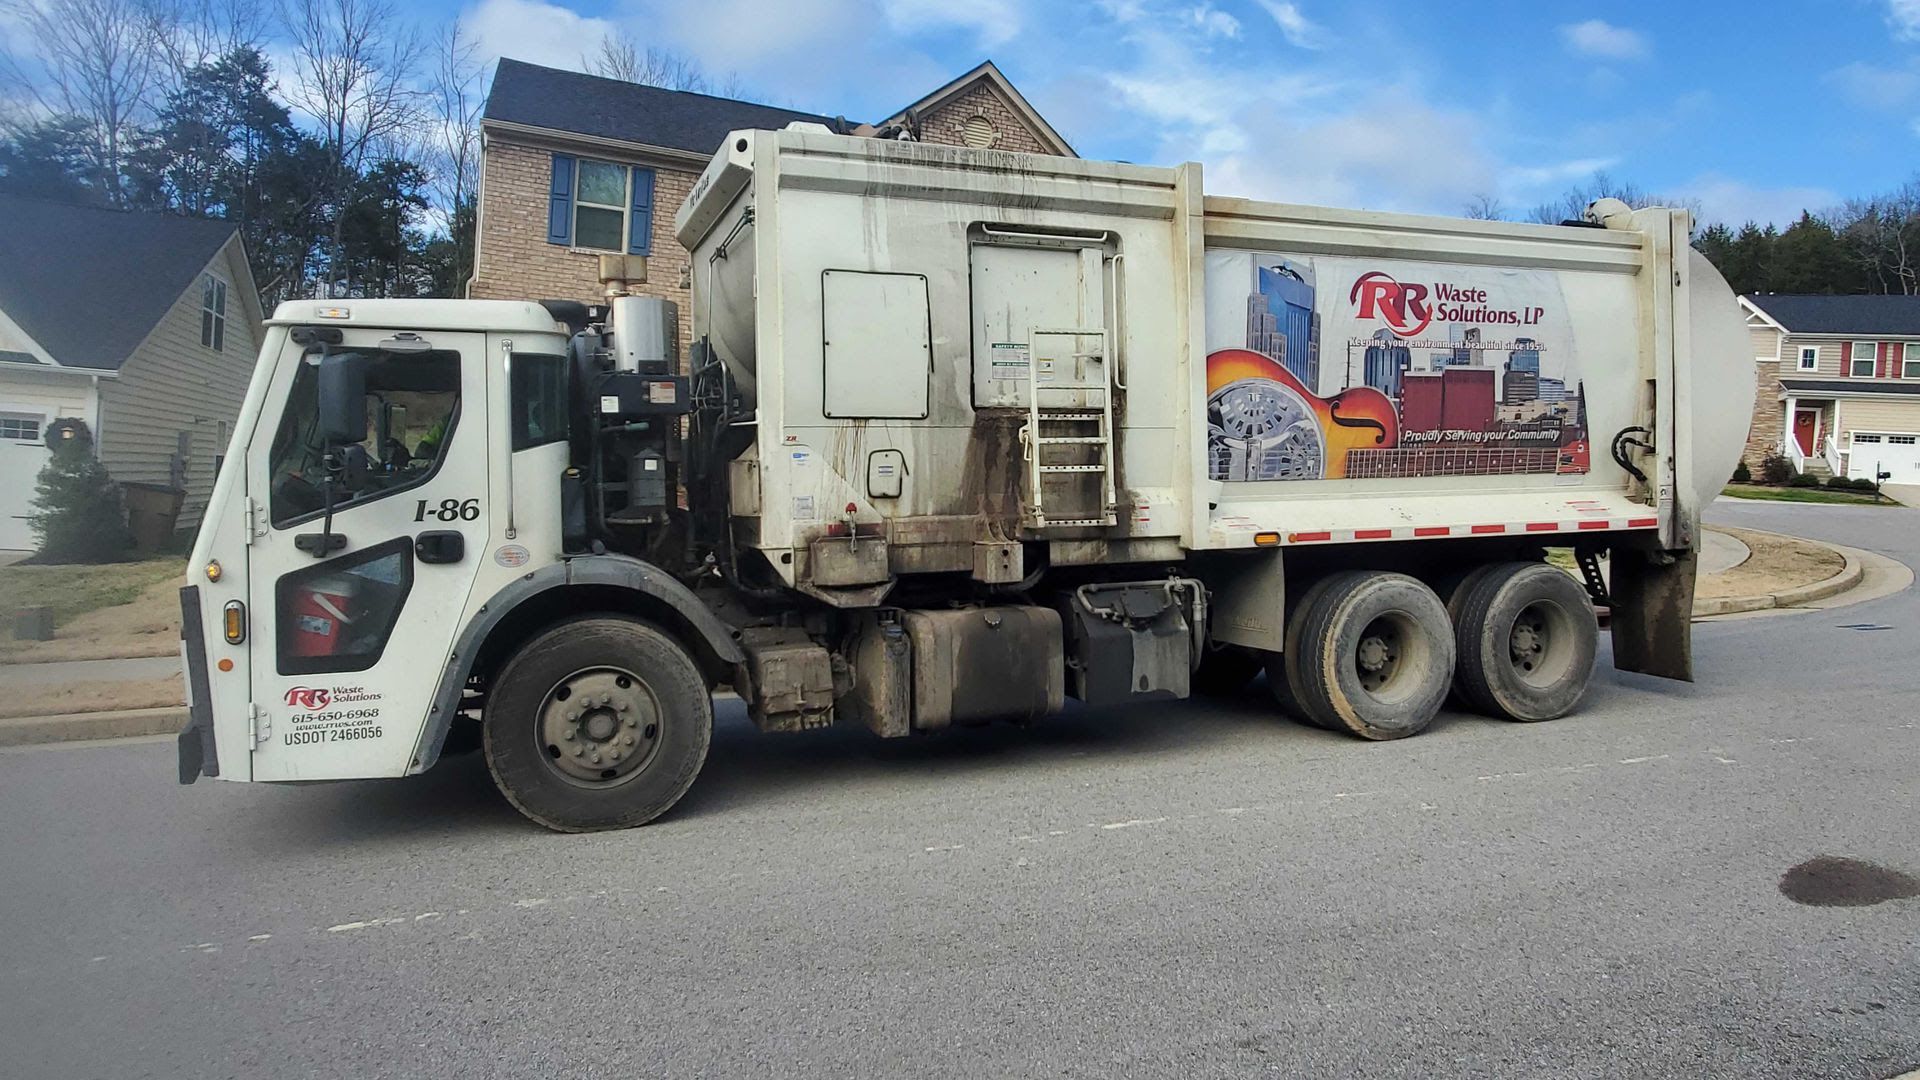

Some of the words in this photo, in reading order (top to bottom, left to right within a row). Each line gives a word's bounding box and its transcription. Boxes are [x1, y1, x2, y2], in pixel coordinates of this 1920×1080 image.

[1434, 283, 1487, 303] Waste
[1355, 281, 1432, 327] RR
[1436, 303, 1521, 327] Solutions,
[1523, 307, 1544, 325] LP
[1350, 337, 1387, 350] Keeping
[1388, 339, 1409, 350] your
[1411, 339, 1463, 350] environment
[1465, 340, 1502, 351] beautiful
[1504, 341, 1524, 351] since
[1404, 429, 1443, 442] Proudly
[1445, 429, 1482, 443] Serving
[1483, 432, 1506, 443] your
[1508, 429, 1560, 442] Community
[413, 498, 480, 521] I-86
[287, 689, 330, 708] RR
[332, 686, 364, 694] Waste
[332, 693, 382, 703] Solutions
[291, 708, 379, 723] 615-650-6968
[296, 719, 373, 731] www.rrws.com
[284, 730, 327, 746] USDOT
[330, 726, 382, 742] 2466056
